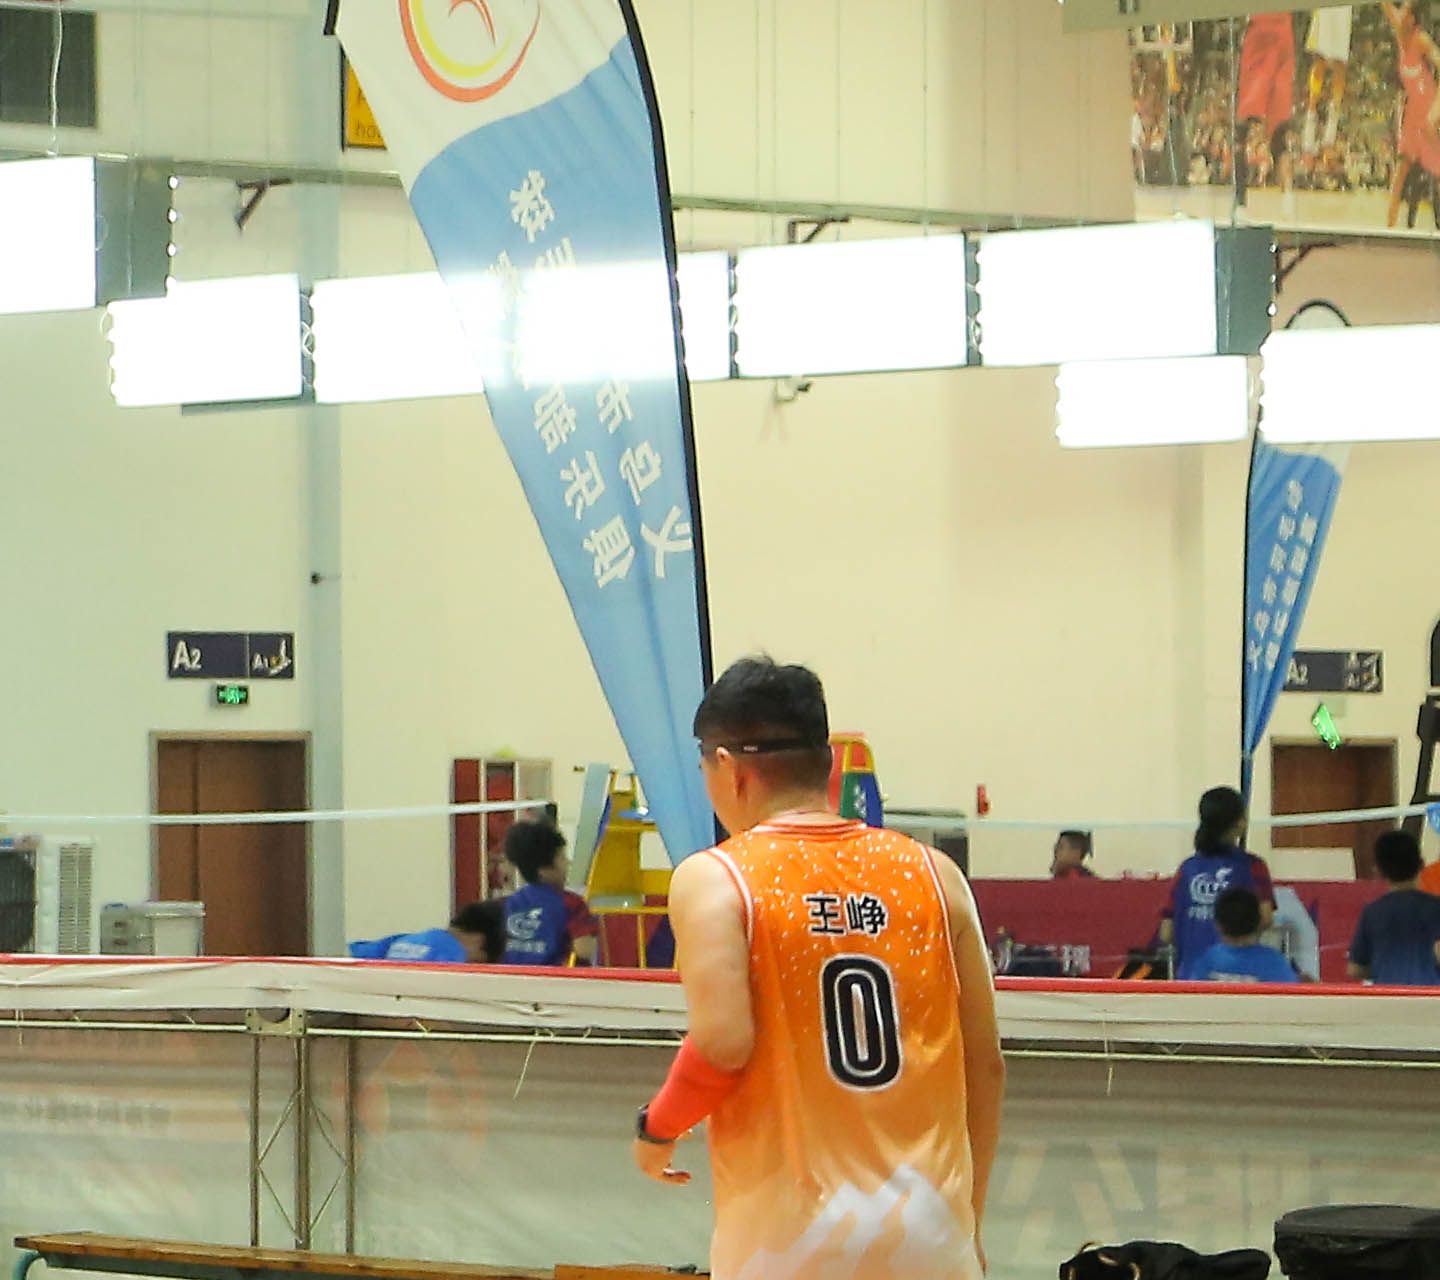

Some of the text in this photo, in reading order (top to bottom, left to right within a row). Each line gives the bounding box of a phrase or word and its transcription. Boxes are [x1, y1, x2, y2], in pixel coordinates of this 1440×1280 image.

[173, 640, 203, 670] A2
[803, 890, 889, 937] 王峥
[818, 952, 905, 1094] 0
